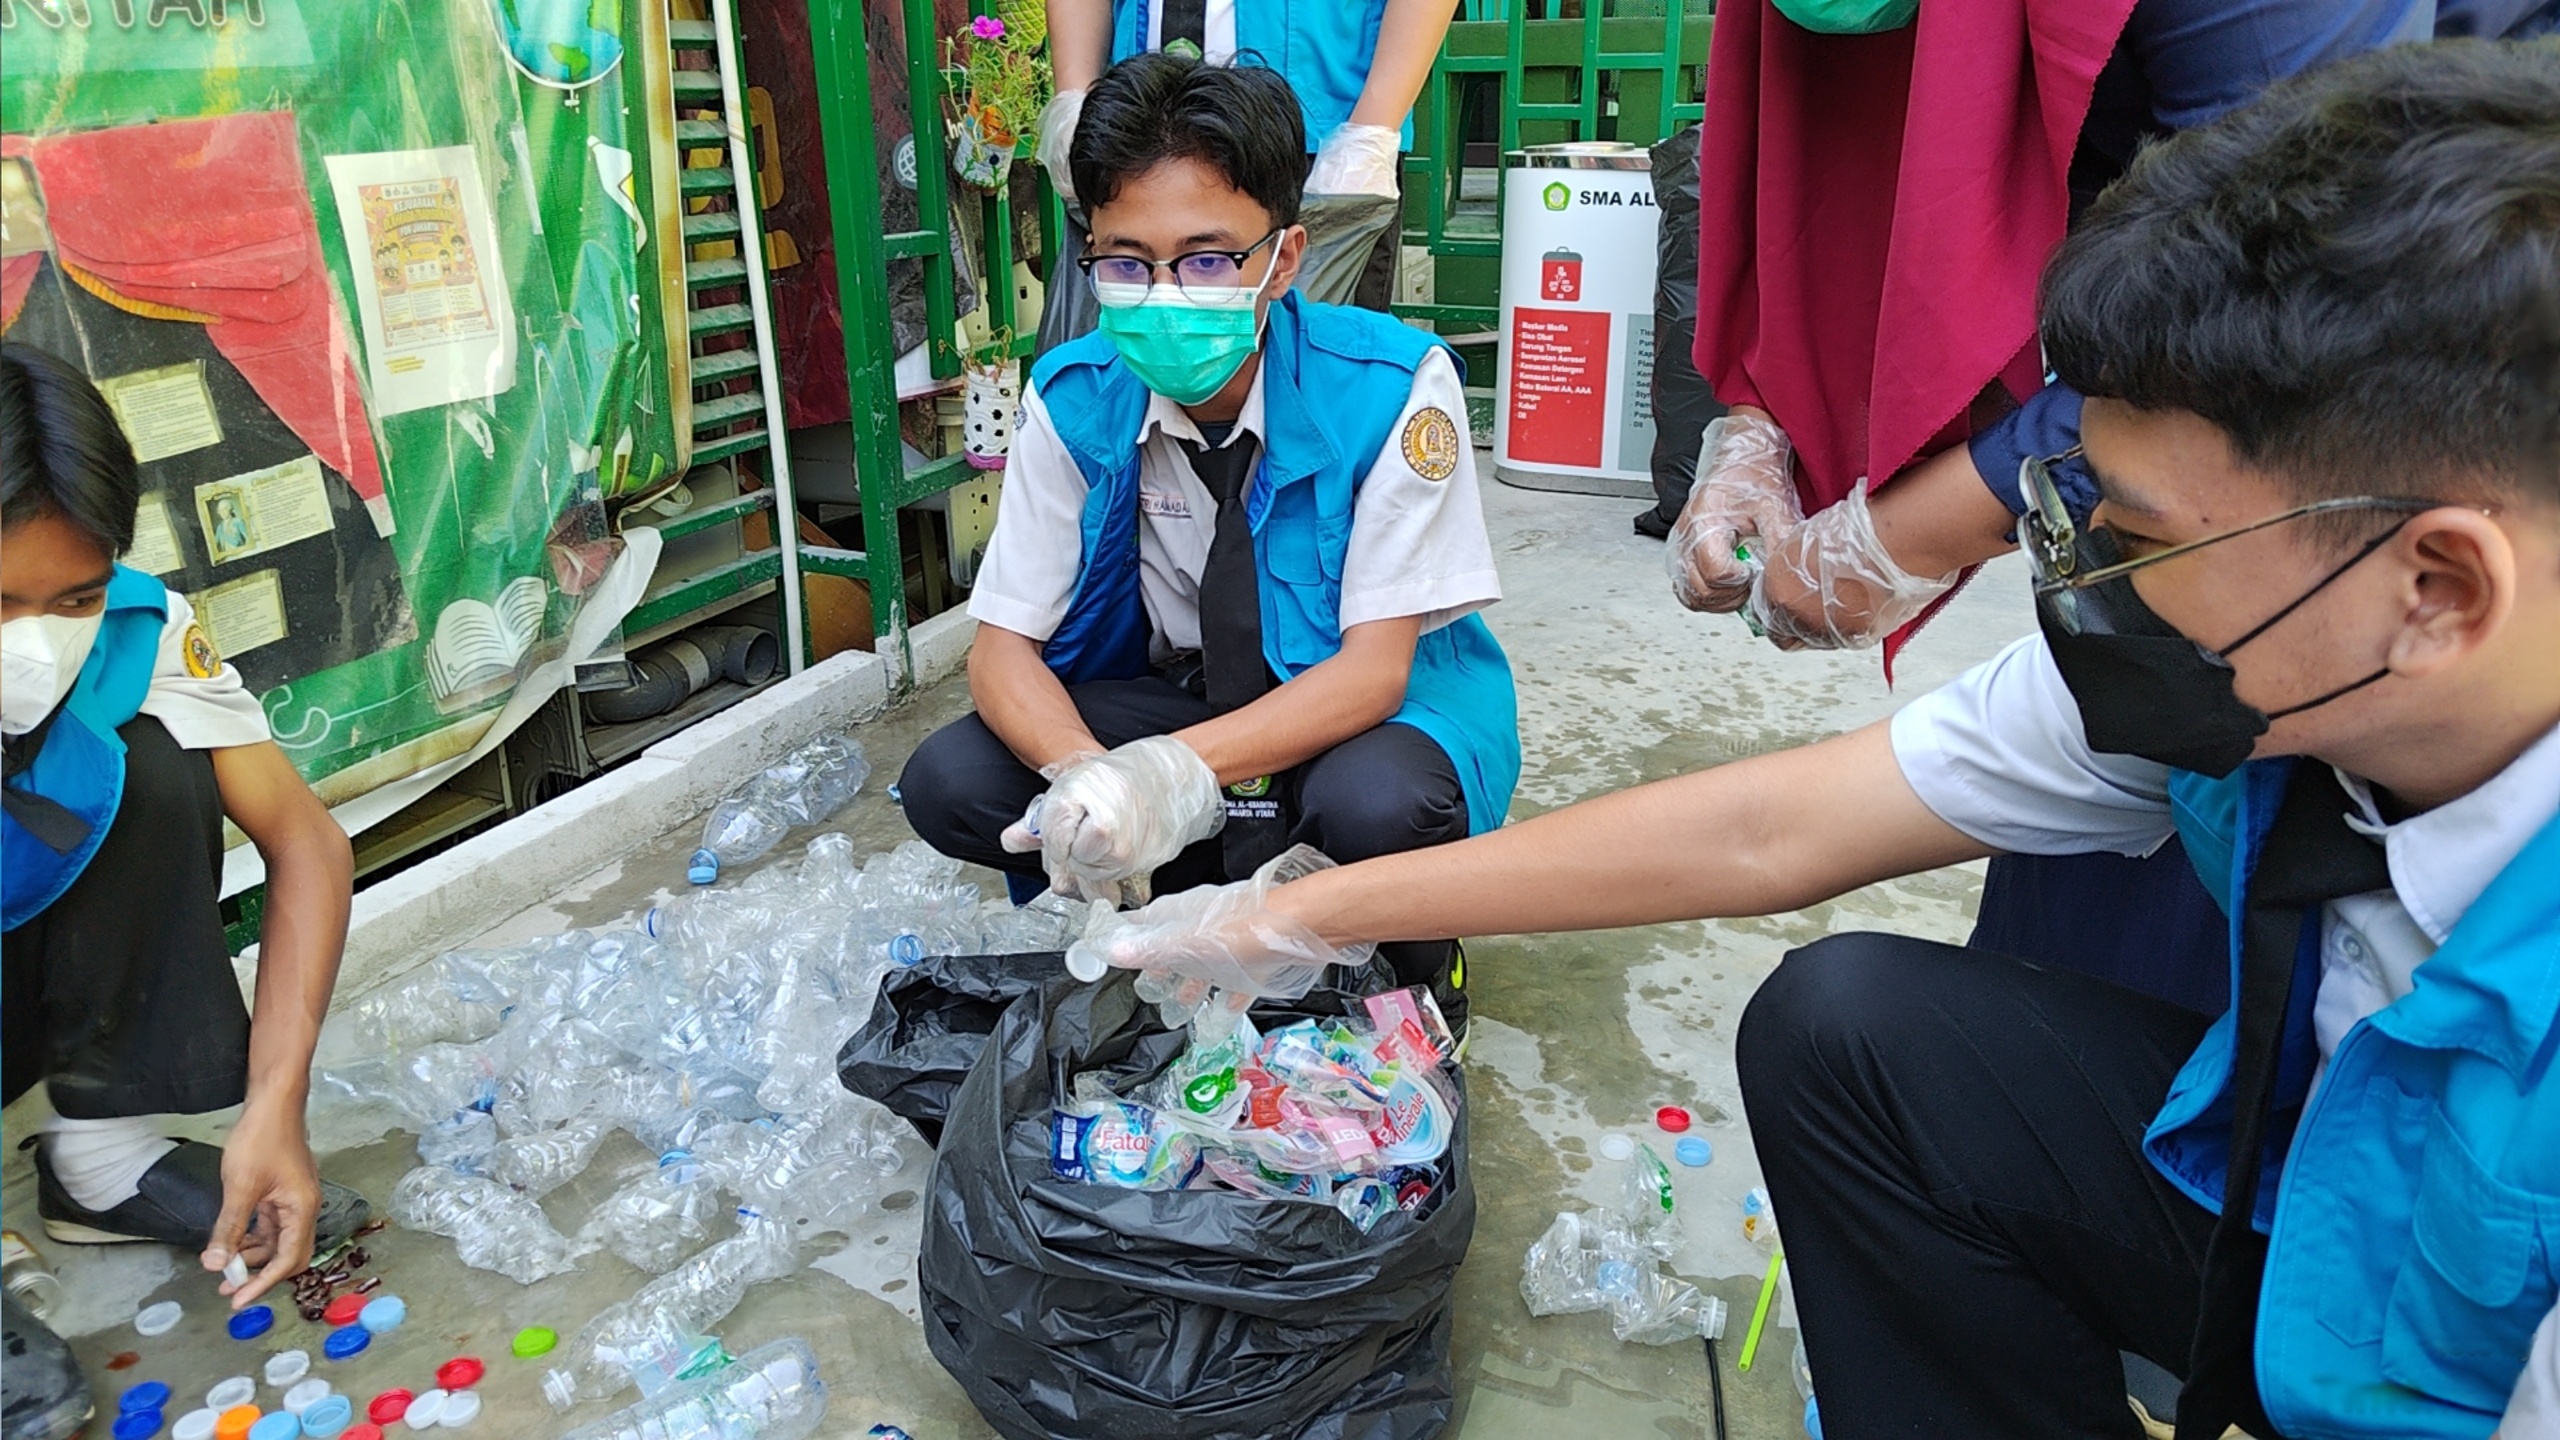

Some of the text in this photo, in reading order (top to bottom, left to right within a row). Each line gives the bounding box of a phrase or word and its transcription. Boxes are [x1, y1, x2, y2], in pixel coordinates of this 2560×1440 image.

[1579, 190, 1655, 206] SMA AL
[1639, 328, 1655, 337] Tiss
[1637, 350, 1655, 359] Kap
[1634, 390, 1651, 399] Styr
[1390, 1100, 1407, 1121] Le
